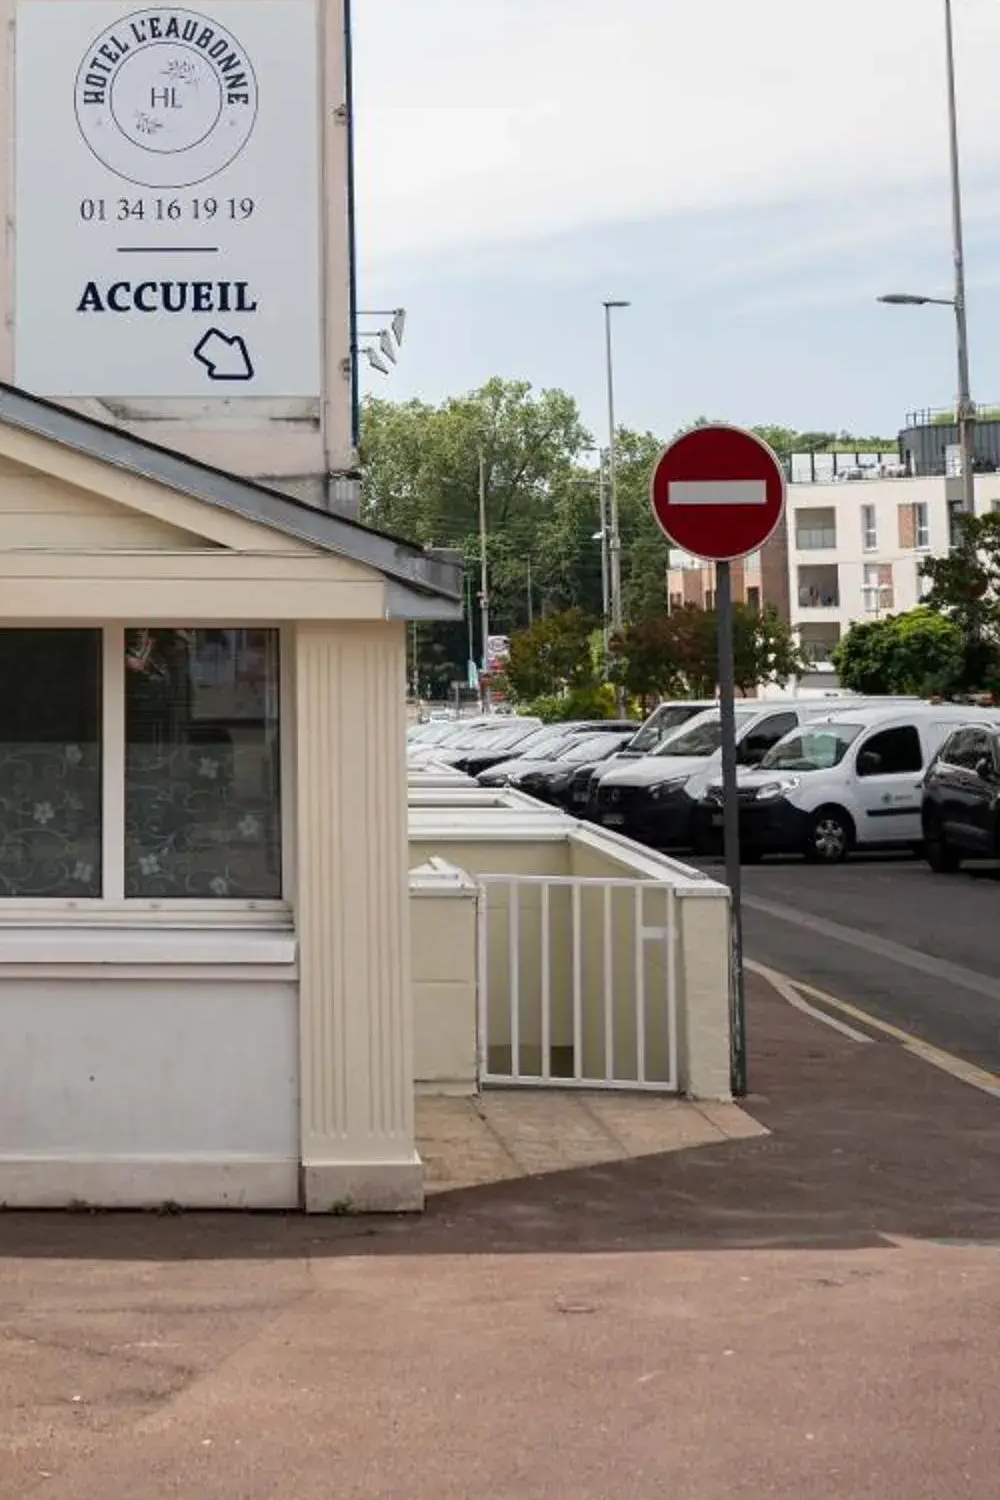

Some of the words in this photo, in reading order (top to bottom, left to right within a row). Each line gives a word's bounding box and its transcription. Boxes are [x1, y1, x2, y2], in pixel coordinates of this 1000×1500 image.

[83, 34, 130, 105] HOTEL
[131, 17, 250, 106] L'EAUBONNE
[151, 87, 183, 109] HL
[80, 198, 107, 222] 01
[116, 198, 145, 222] 34
[155, 198, 182, 221] 16
[192, 198, 218, 221] 19
[229, 198, 255, 221] 19
[76, 280, 258, 313] ACCUEIL
